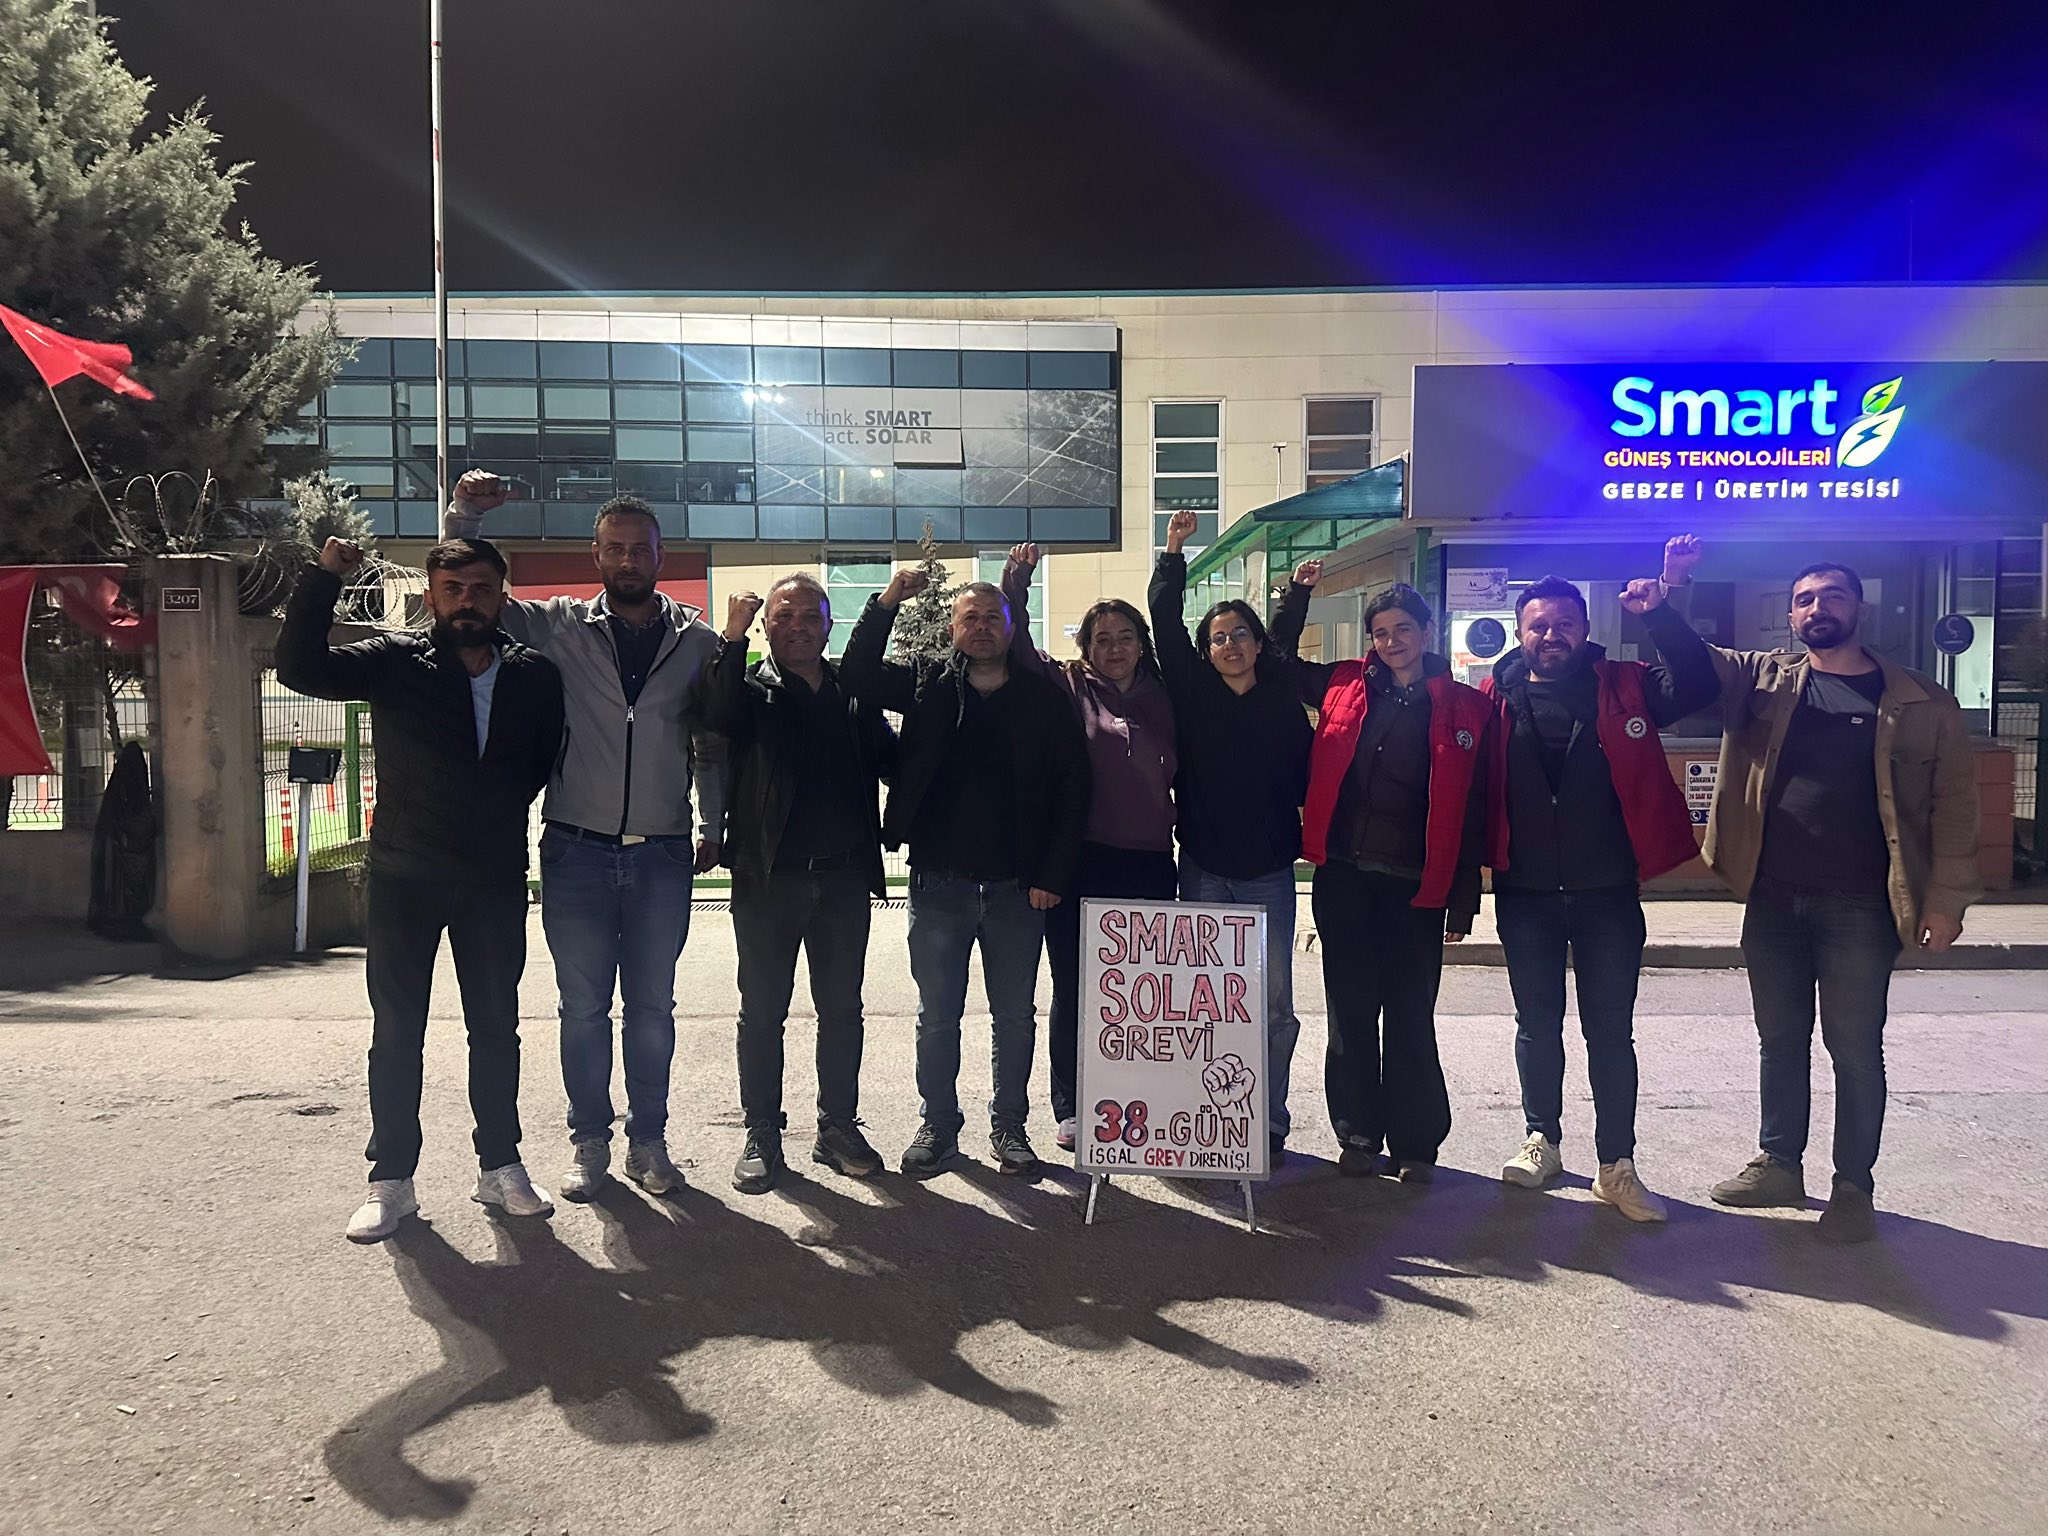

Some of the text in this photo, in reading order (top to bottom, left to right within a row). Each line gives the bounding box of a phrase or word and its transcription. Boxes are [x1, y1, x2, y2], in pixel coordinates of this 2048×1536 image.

[806, 408, 932, 427] think. SMART
[1610, 377, 1838, 437] Smart
[825, 428, 933, 445] act. SOLAR
[1603, 447, 1831, 469] GÜNEŞ TEKNOLOJİLERİ
[1602, 482, 1684, 499] GEBZE
[1715, 479, 1808, 498] ÜRETİM
[1820, 478, 1899, 498] TESİSİ
[165, 594, 197, 604] 3207
[1099, 910, 1255, 967] SMART
[1100, 968, 1251, 1024] SOLAR
[1099, 1022, 1214, 1062] GREVİ
[1144, 1147, 1186, 1167] GREV
